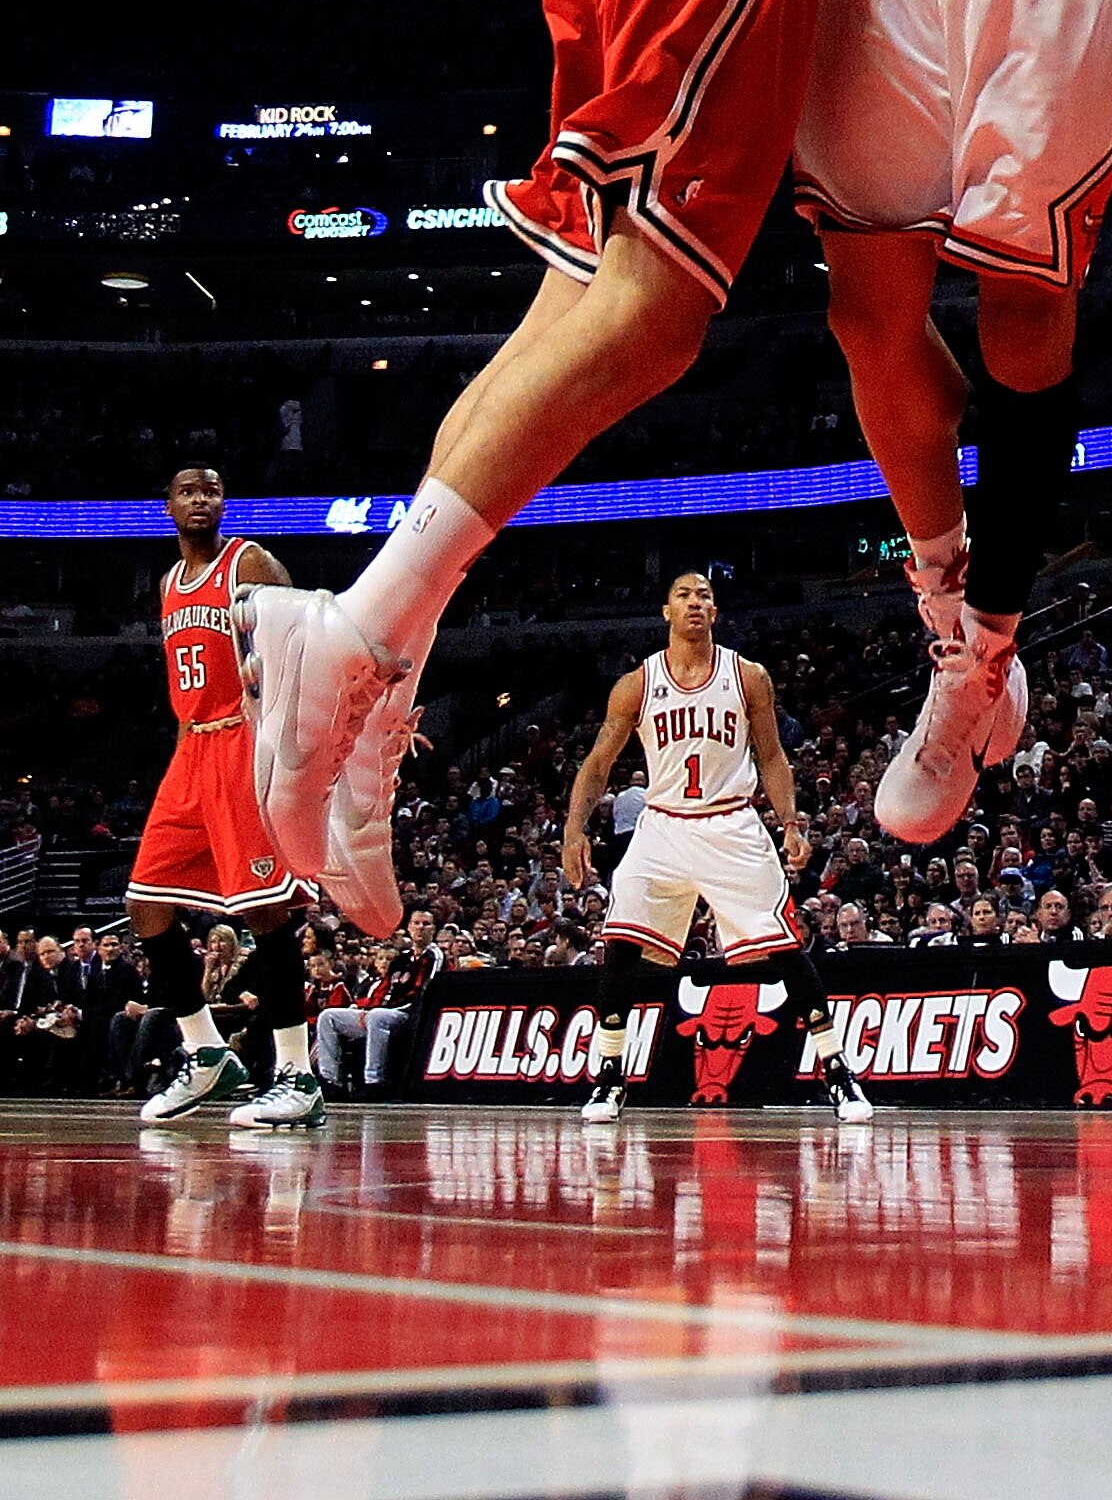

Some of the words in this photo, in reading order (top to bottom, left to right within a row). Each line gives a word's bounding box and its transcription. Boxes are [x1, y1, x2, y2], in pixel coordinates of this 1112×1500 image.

[259, 107, 288, 123] KID
[290, 105, 336, 123] ROCK
[220, 122, 294, 139] FEBRUARY
[293, 210, 363, 229] comcast
[176, 644, 206, 691] 55
[653, 706, 737, 751] BULLS
[684, 753, 703, 799] 1
